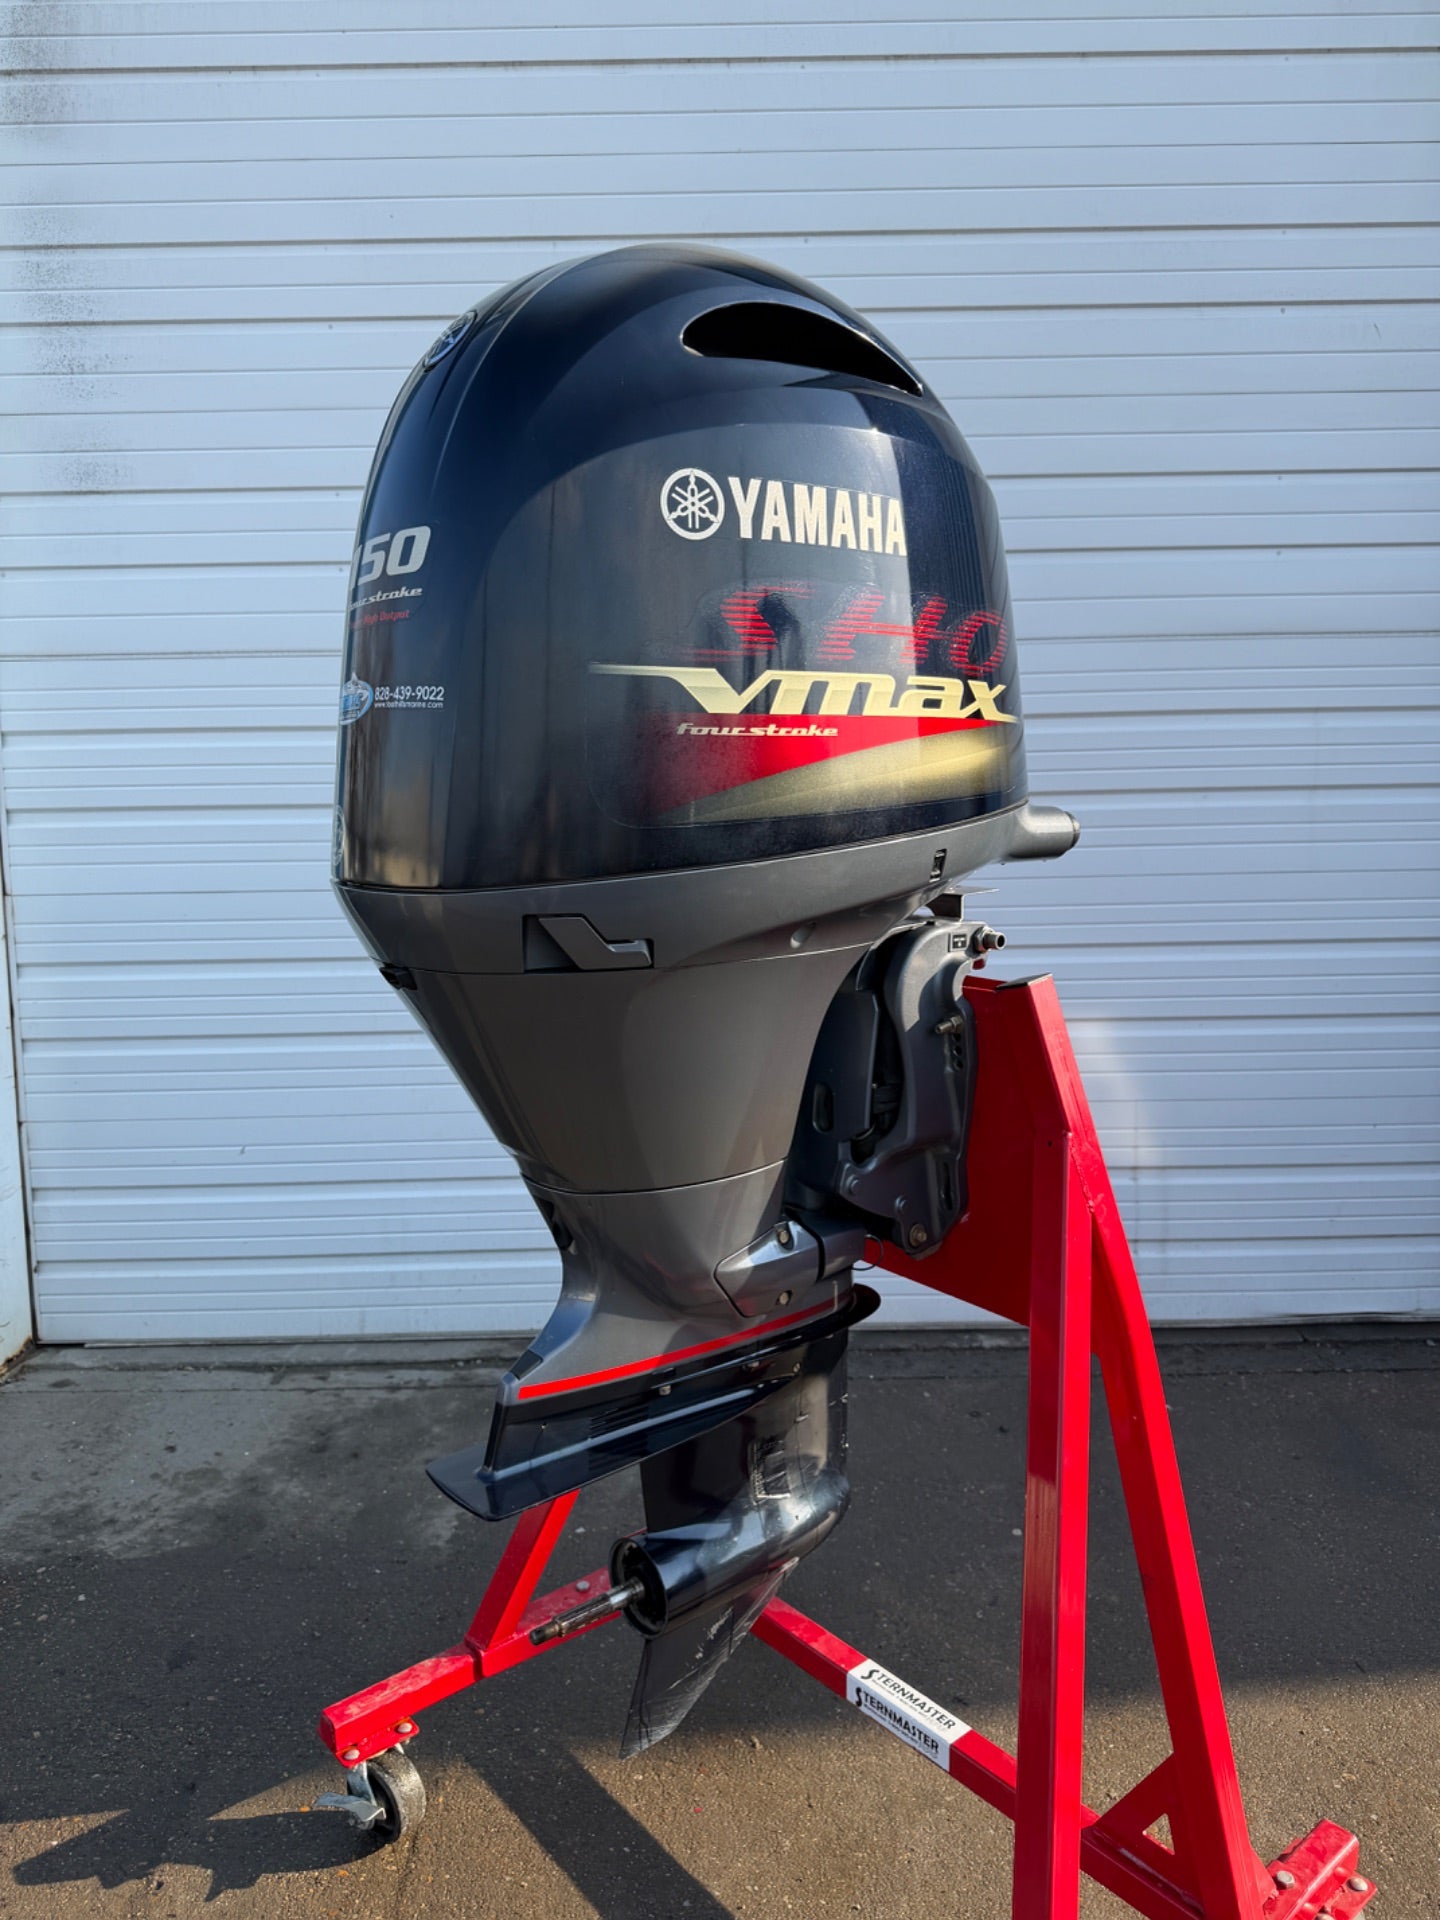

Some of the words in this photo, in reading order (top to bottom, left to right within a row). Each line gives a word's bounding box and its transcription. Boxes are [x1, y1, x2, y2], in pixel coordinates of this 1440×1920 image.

[728, 476, 908, 557] YAMAHA
[374, 686, 445, 702] 828-439-9022
[855, 1687, 939, 1754] STERNMASTER
[861, 1669, 956, 1729] STERNMASTER
